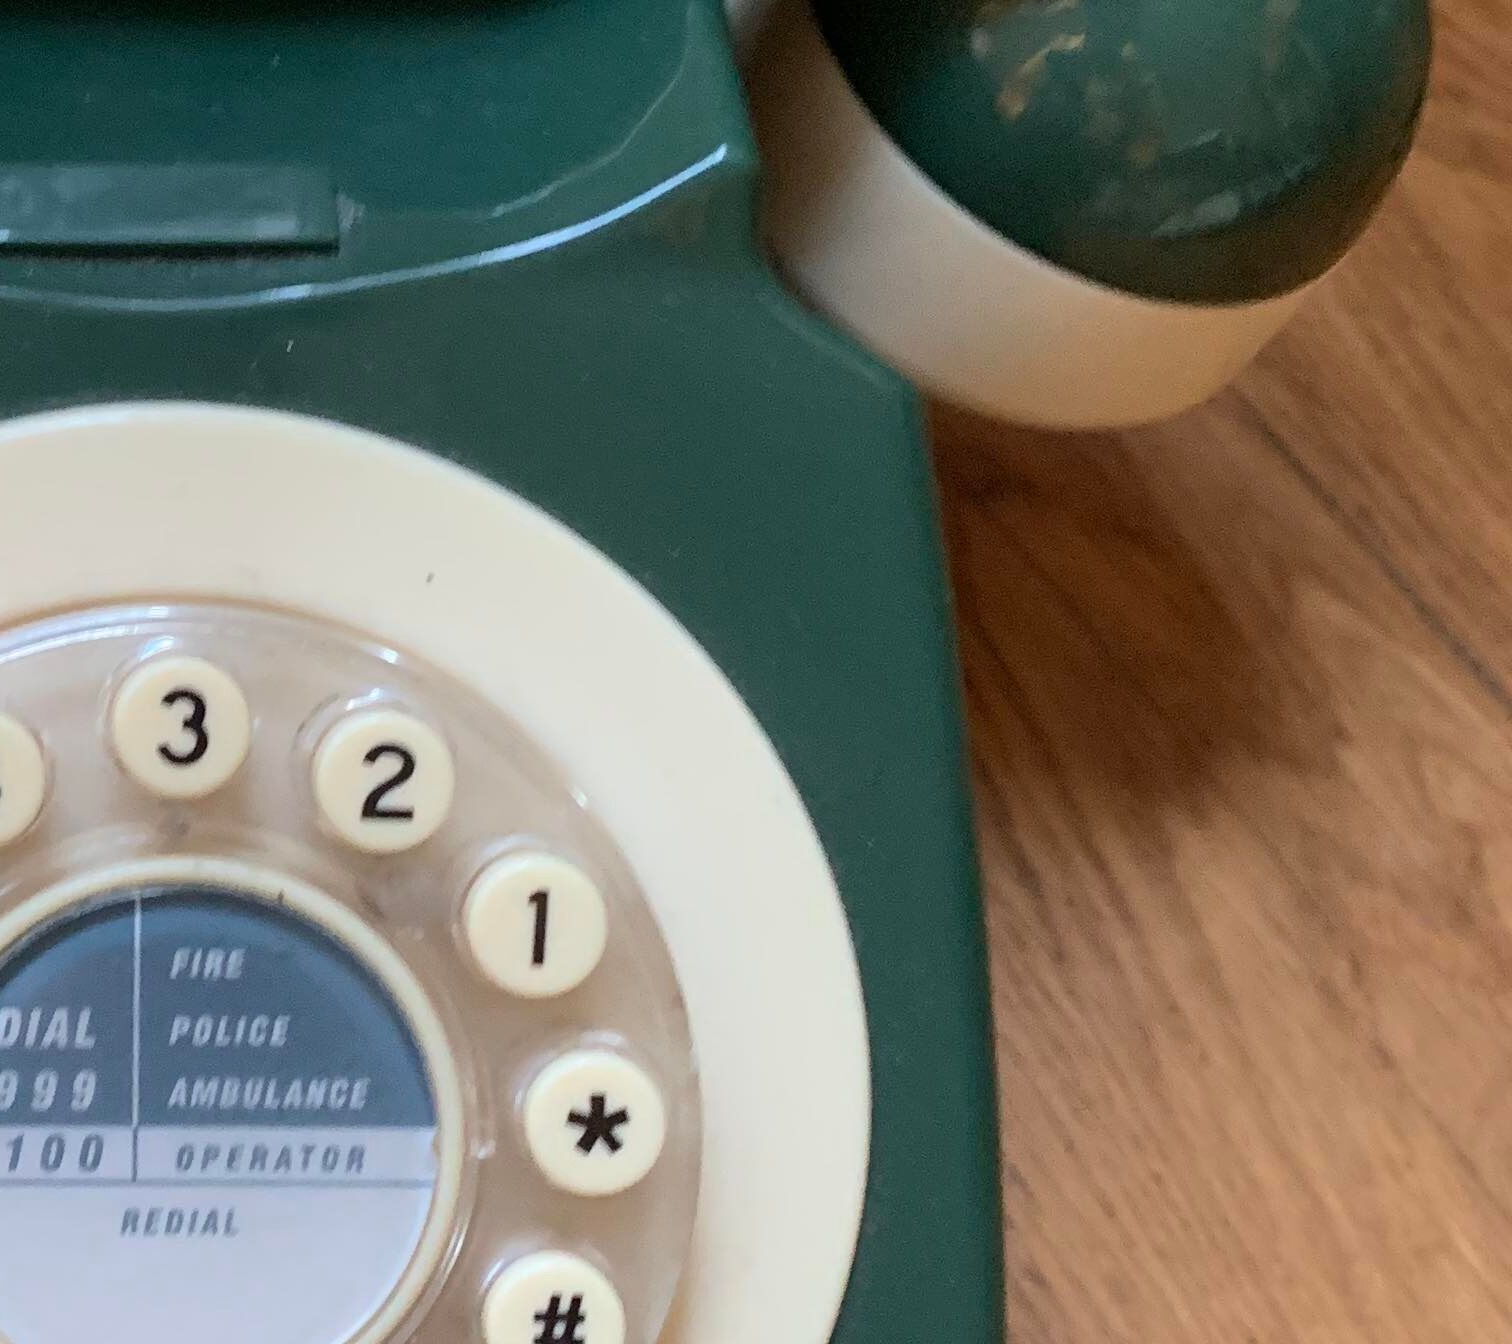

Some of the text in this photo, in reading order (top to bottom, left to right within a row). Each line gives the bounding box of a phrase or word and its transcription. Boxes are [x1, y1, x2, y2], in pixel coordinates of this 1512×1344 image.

[158, 689, 208, 766] 3
[362, 744, 415, 820] 2
[529, 891, 548, 964] 1
[169, 948, 246, 980] FIRE
[169, 1014, 291, 1047] POLICE
[167, 1077, 371, 1112] AMBULANCE
[6, 1133, 105, 1173] 100
[175, 1144, 367, 1174] OPERATOR
[120, 1208, 240, 1237] REDIAL
